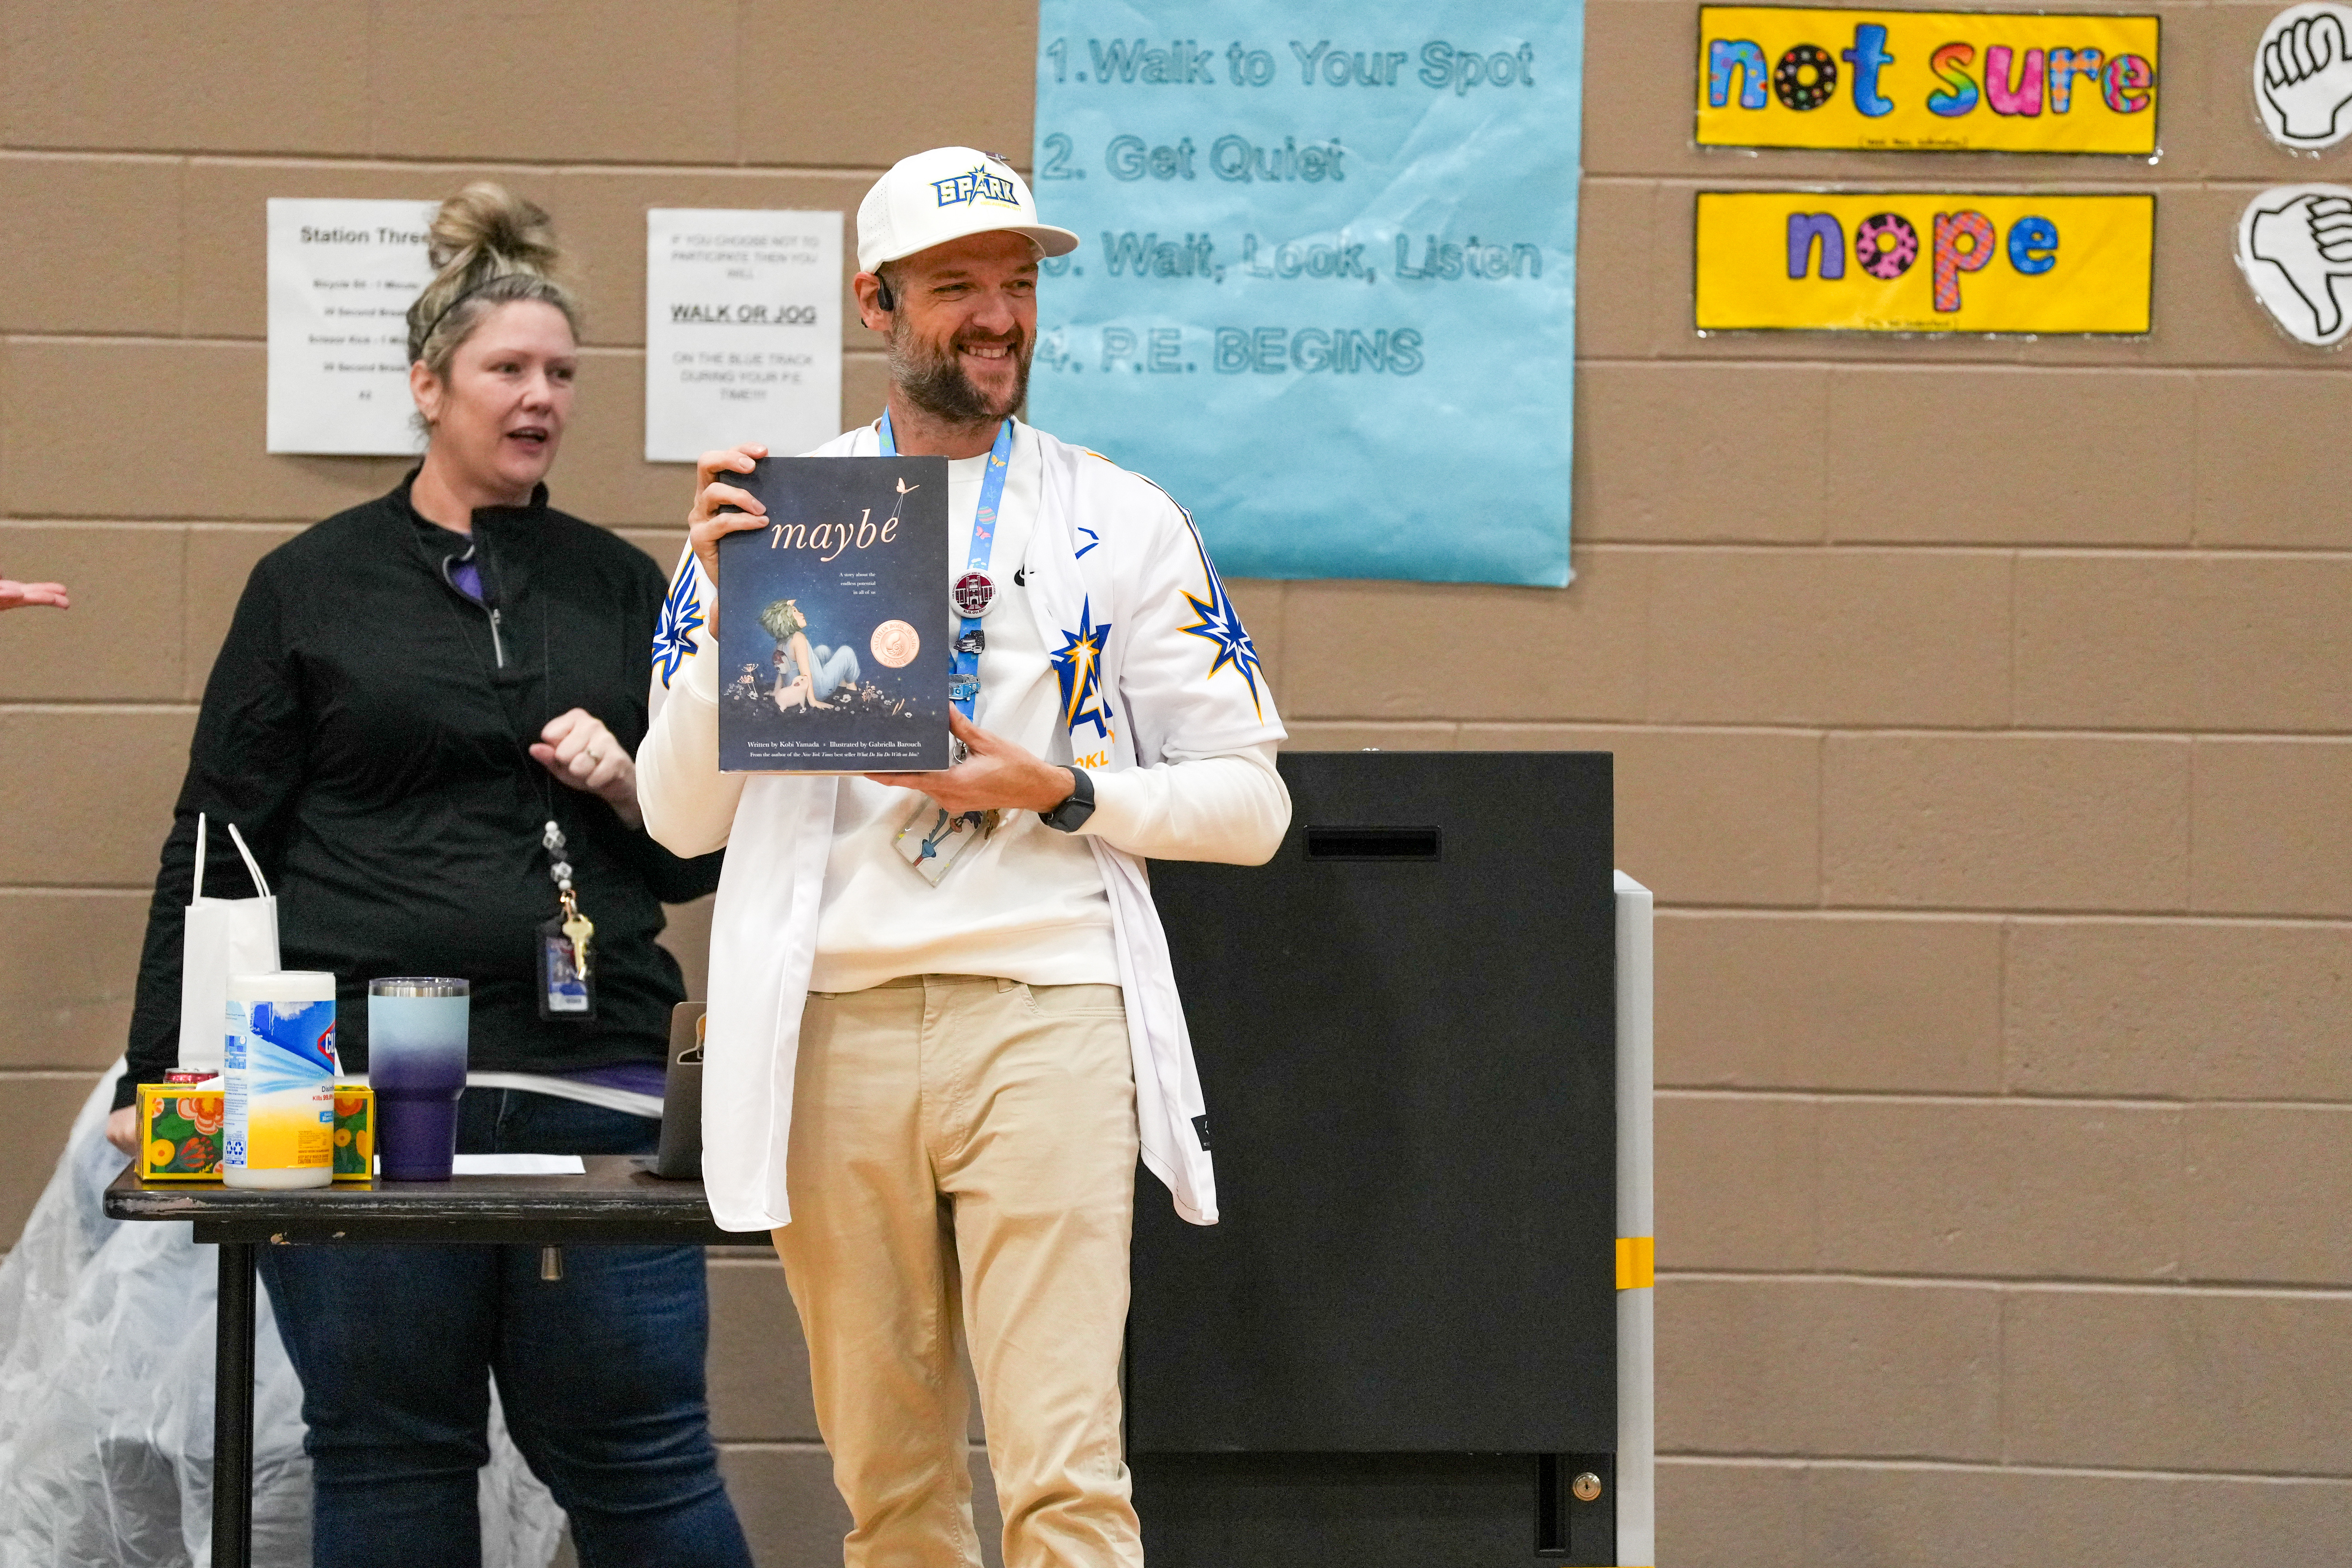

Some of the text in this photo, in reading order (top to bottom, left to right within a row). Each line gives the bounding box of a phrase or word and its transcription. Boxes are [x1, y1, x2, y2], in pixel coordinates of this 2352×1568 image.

[1225, 40, 1276, 88] to
[1289, 39, 1407, 88] Your
[1417, 39, 1535, 97] Spot
[1709, 23, 2153, 117] not sure
[1040, 132, 1346, 183] 2. Get Quiet
[936, 164, 1017, 206] SPARK
[301, 226, 369, 244] Station
[1101, 232, 1225, 283] Wait,
[1243, 234, 1375, 282] Look,
[1396, 233, 1543, 278] Listen
[1786, 210, 2060, 312] nope
[671, 304, 817, 325] WALK OR JOG
[1101, 326, 1197, 374] P.E.
[1213, 326, 1423, 375] BEGINS
[771, 508, 899, 562] maybe
[325, 1033, 335, 1053] CL
